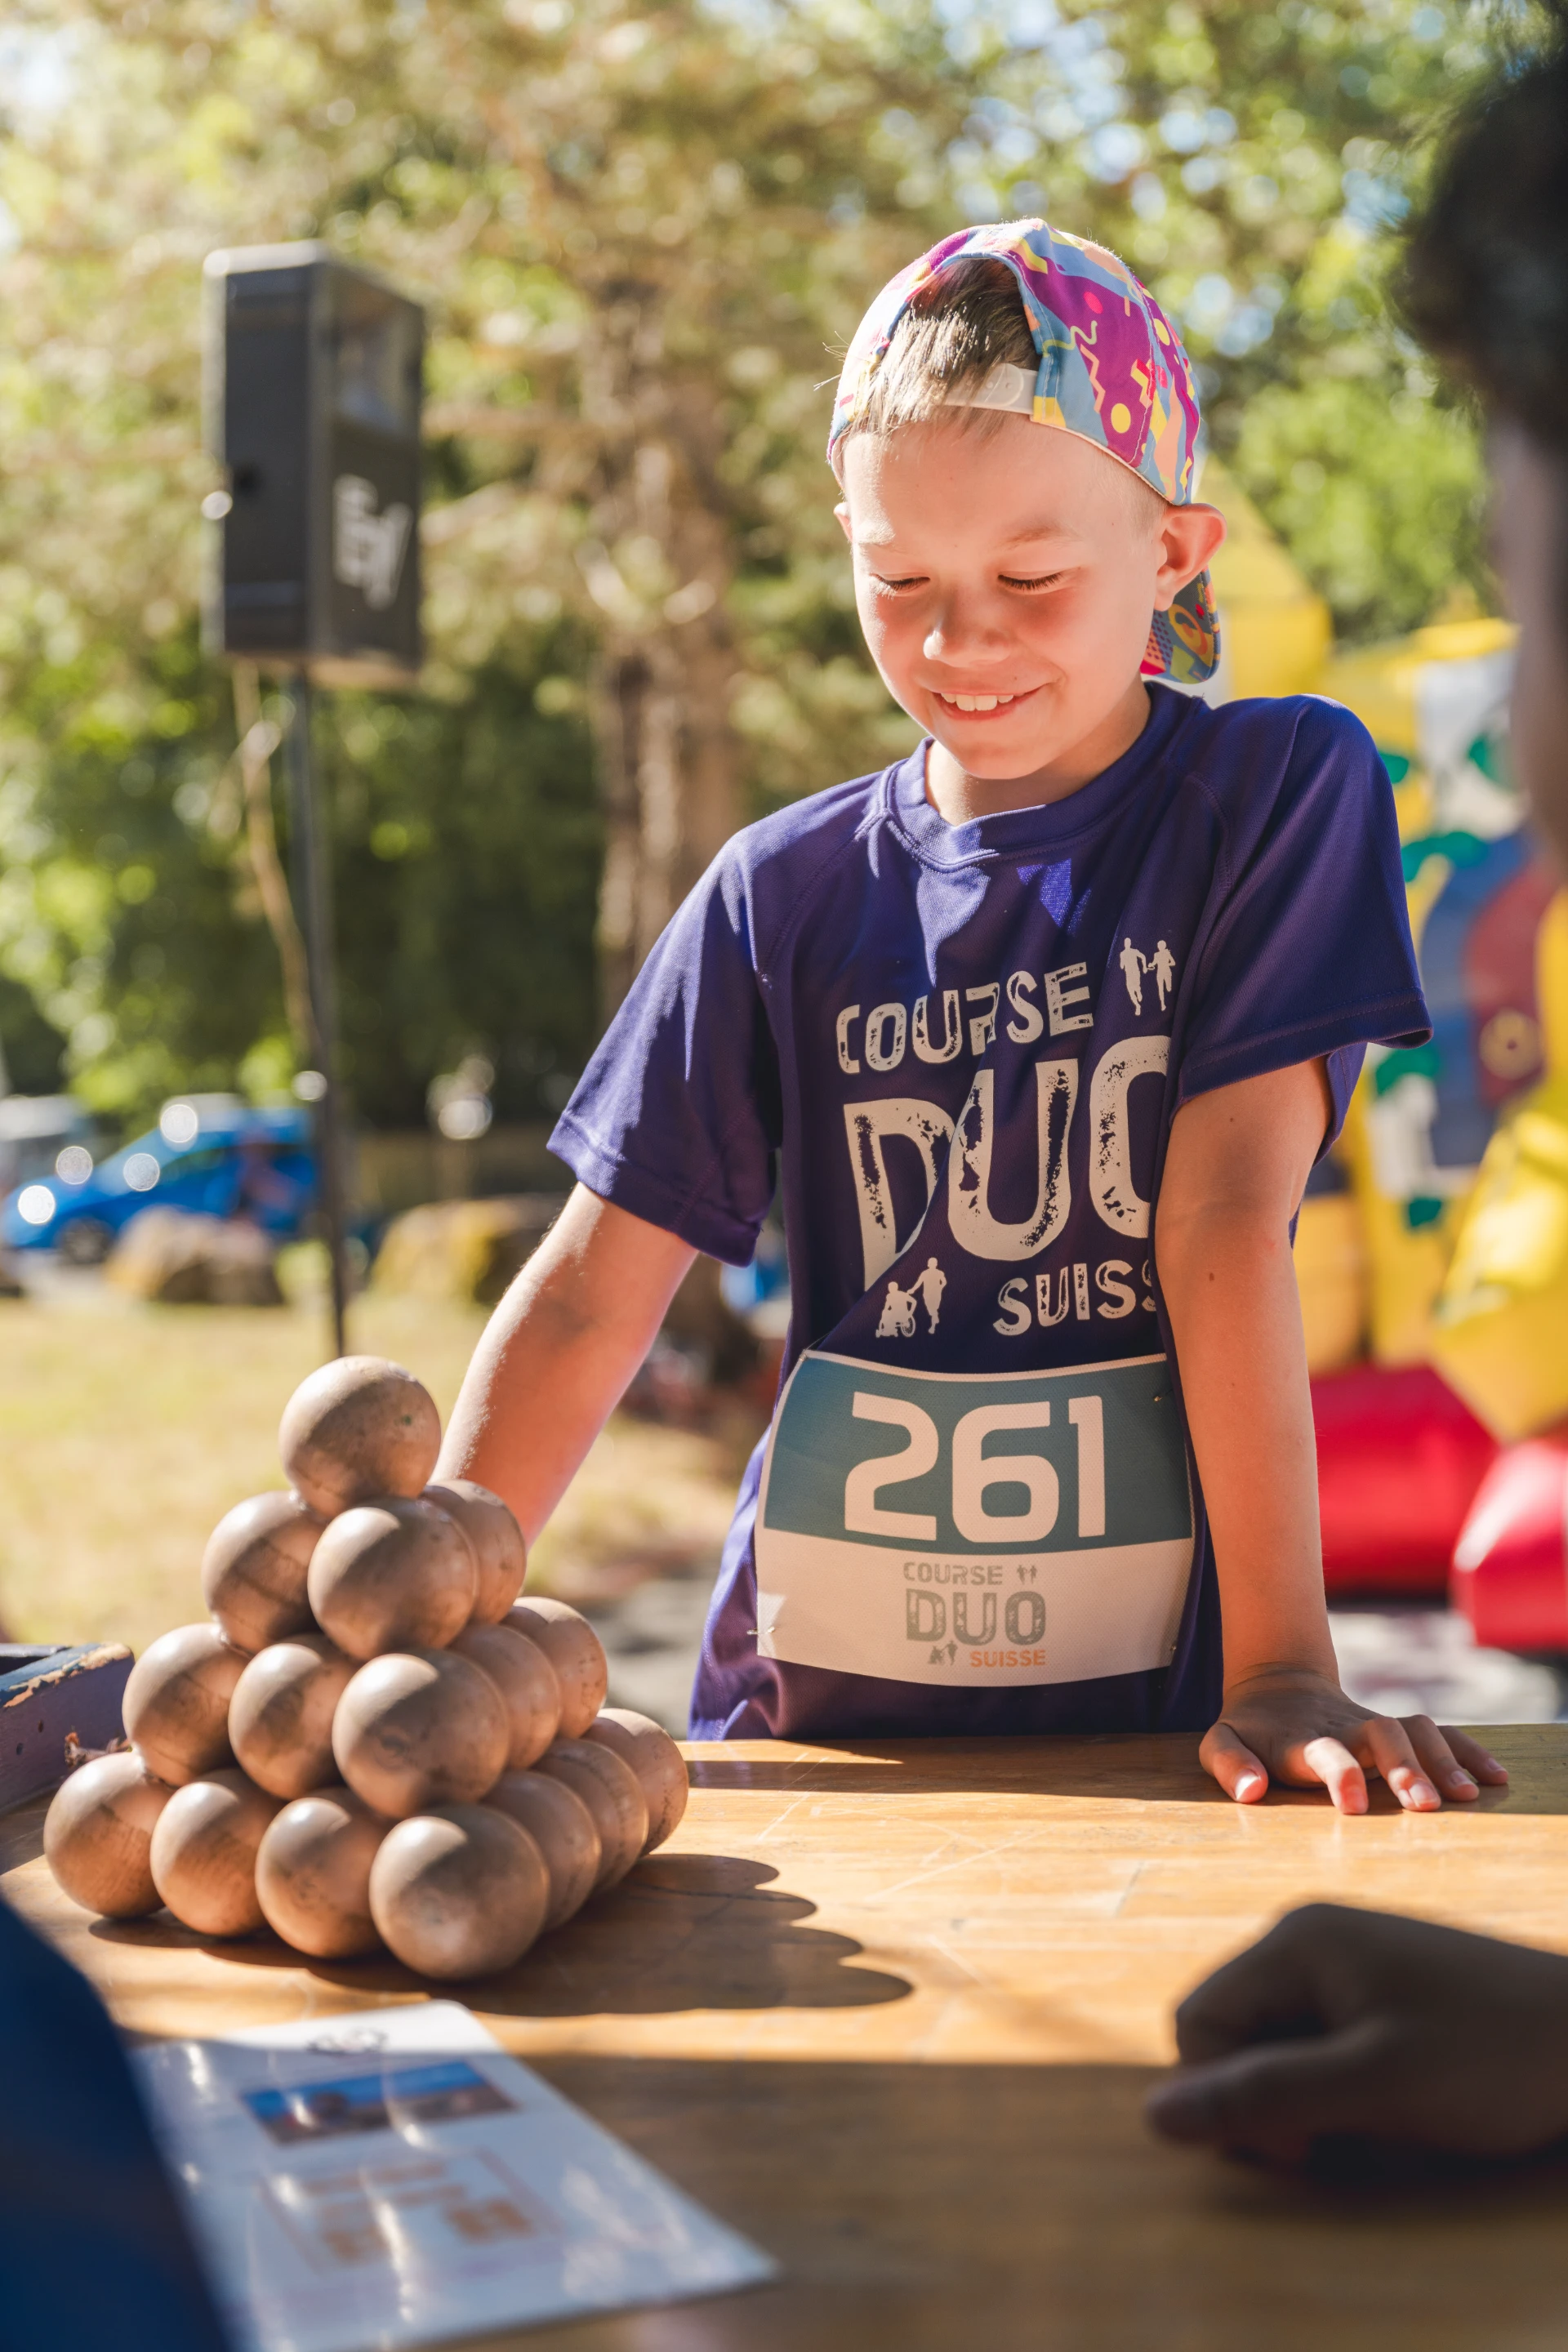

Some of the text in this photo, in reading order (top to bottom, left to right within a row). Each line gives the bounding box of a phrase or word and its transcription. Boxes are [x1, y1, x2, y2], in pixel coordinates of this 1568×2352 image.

[836, 962, 1094, 1074] COURSE
[992, 1260, 1156, 1336] SUIS
[844, 1391, 1106, 1543] 261
[903, 1561, 1003, 1585] COURSE
[906, 1588, 1046, 1646] DUO
[969, 1650, 1046, 1668] SUISSE
